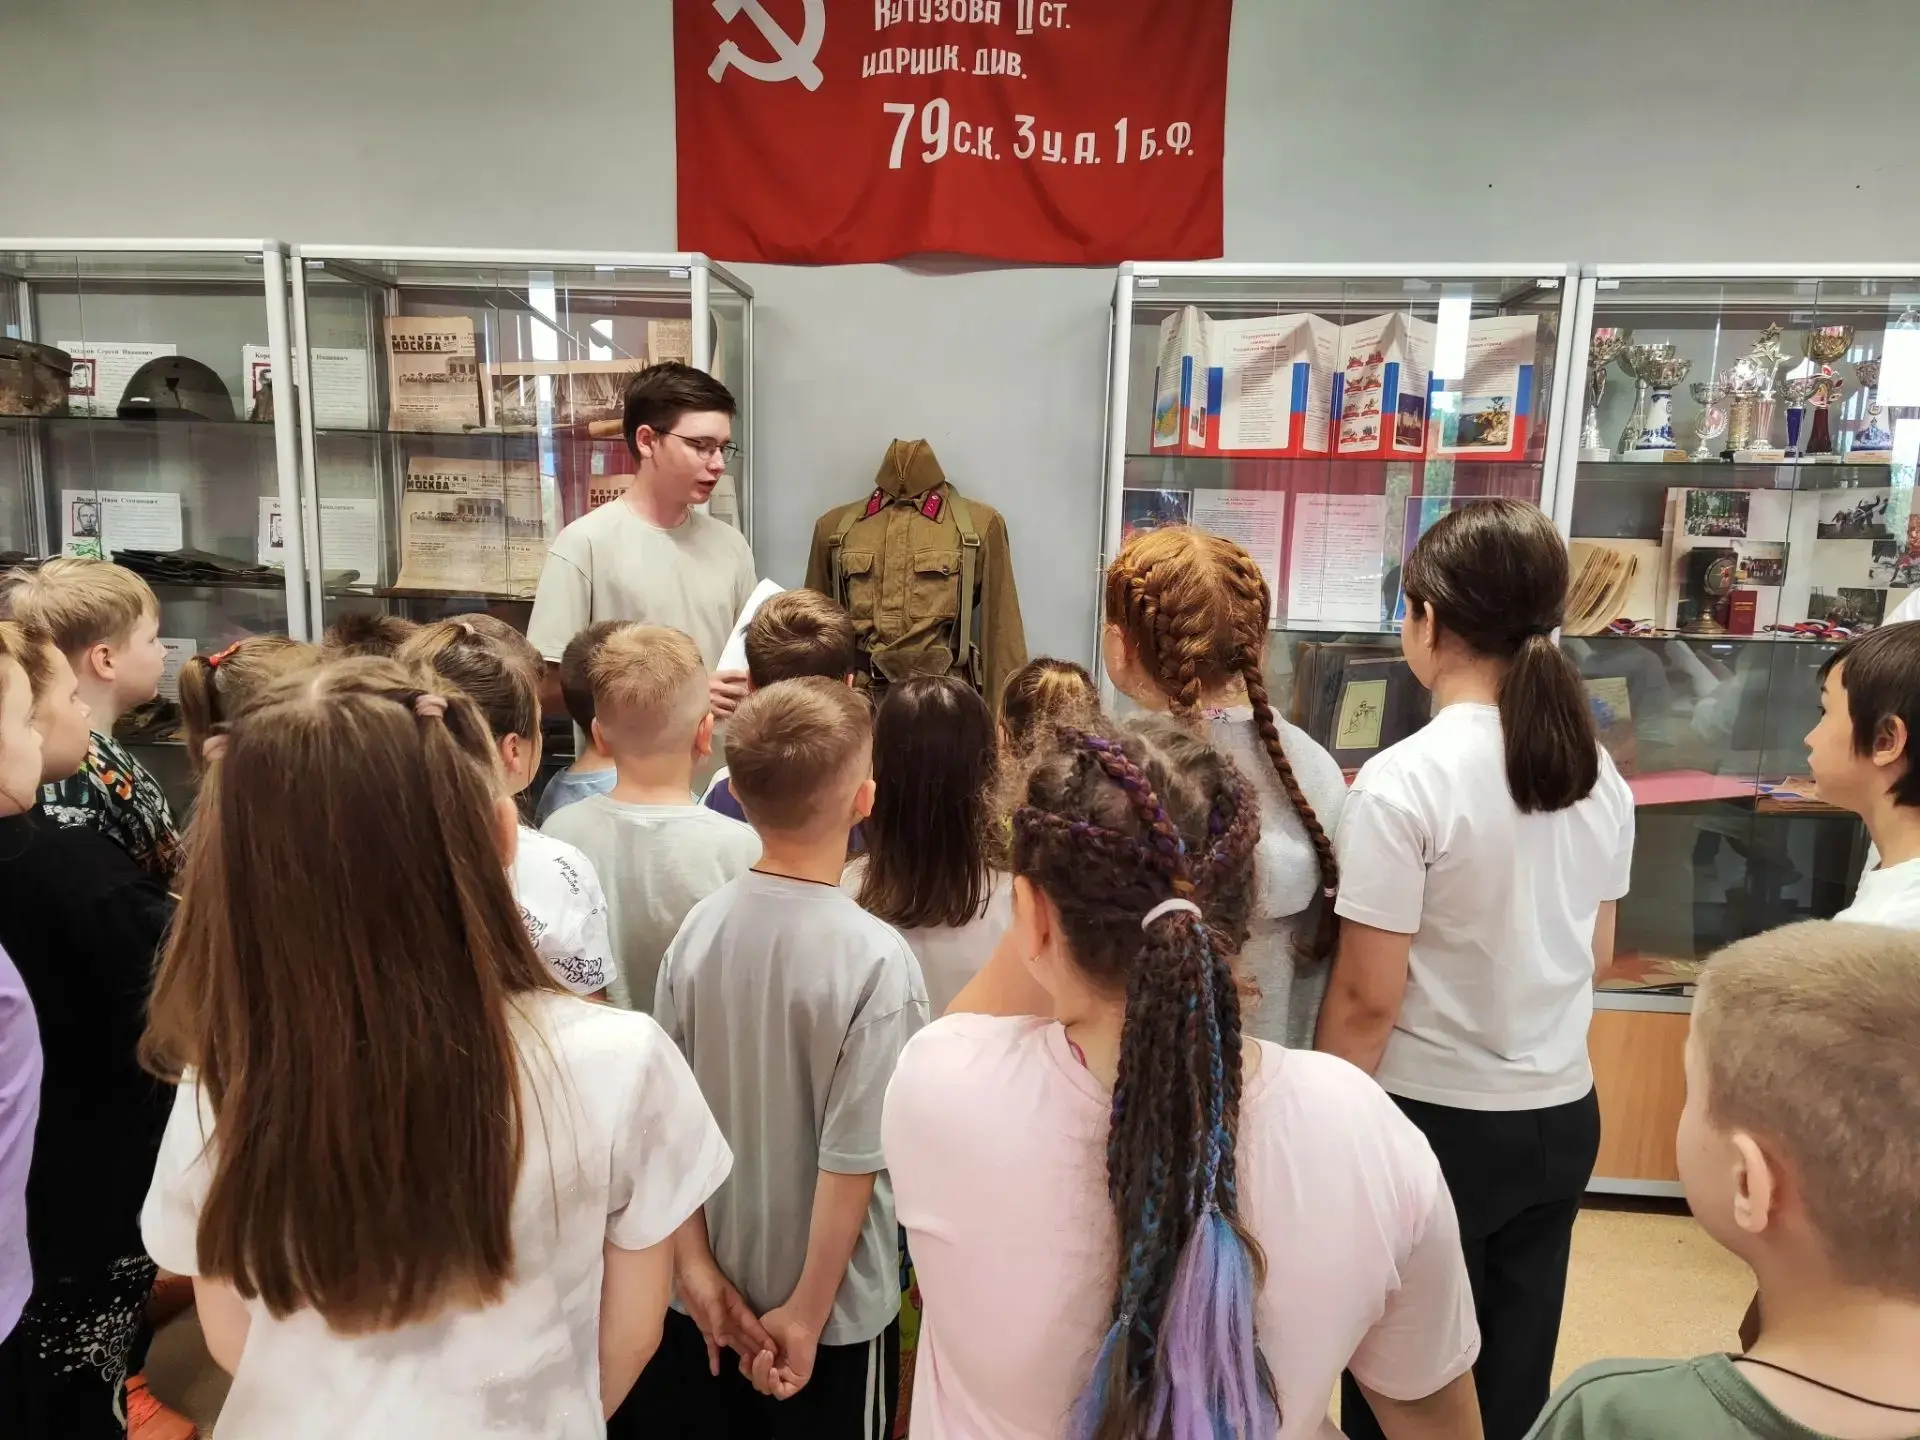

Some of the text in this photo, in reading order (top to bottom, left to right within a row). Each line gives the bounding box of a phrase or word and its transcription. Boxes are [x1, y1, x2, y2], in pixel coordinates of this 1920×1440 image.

[875, 0, 1000, 31] КУТУЗОВА
[391, 341, 442, 351] МОСКВА
[406, 480, 450, 490] МОСКВА
